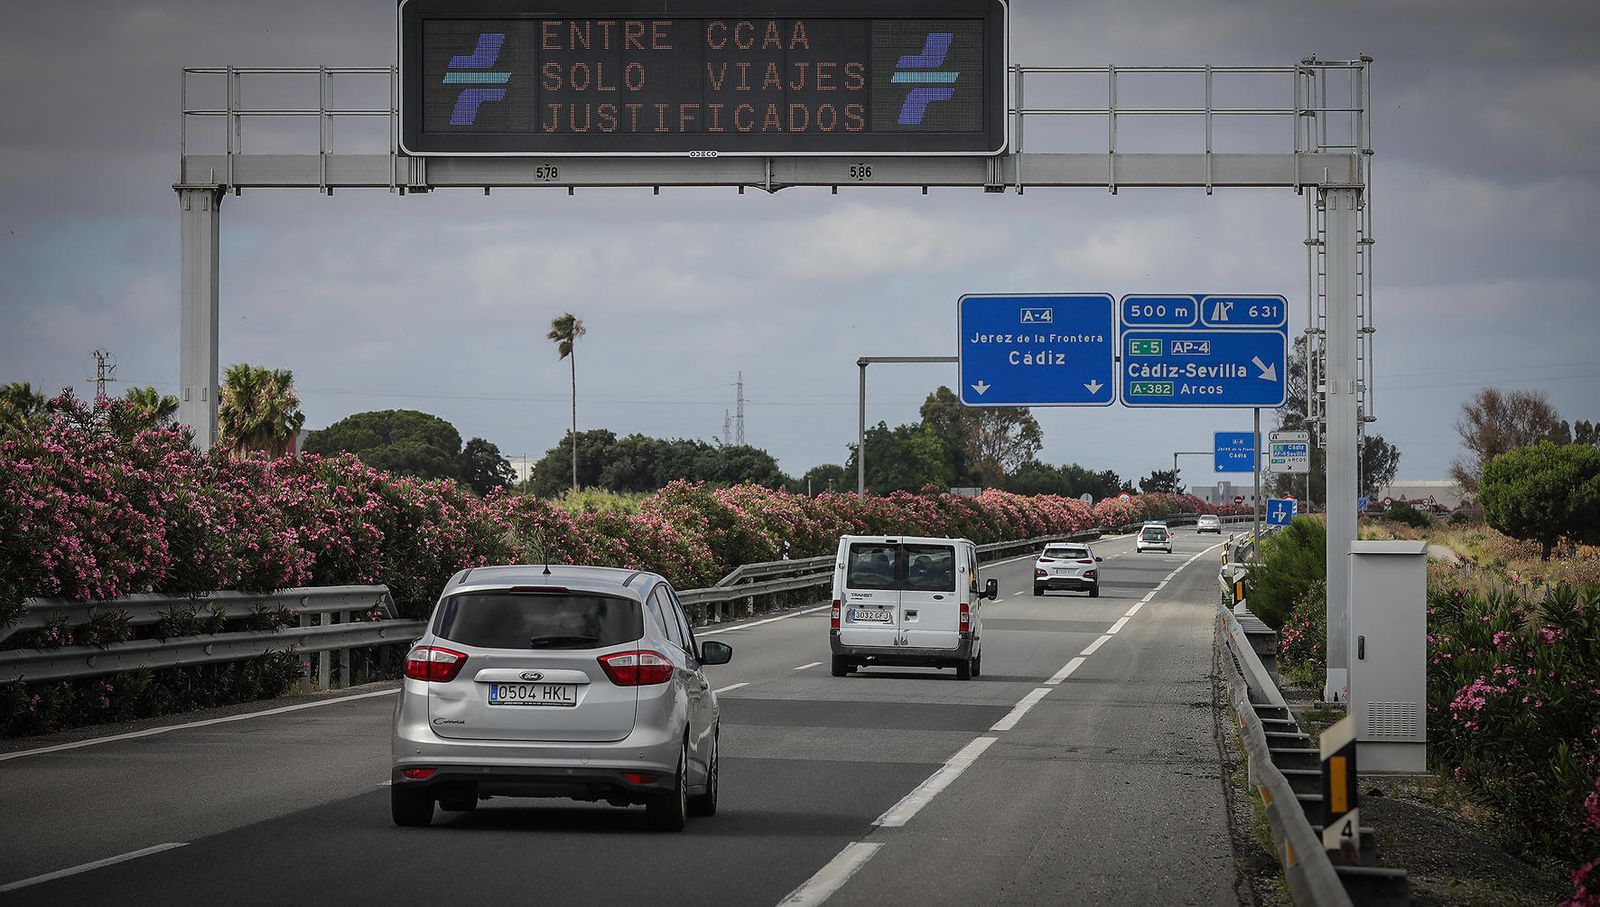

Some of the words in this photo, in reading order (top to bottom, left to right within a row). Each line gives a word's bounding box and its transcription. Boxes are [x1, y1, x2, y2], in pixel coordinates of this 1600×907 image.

[542, 20, 674, 50] ENTRE
[707, 20, 810, 50] CCAA
[542, 62, 646, 92] SOLO
[707, 62, 866, 92] VIAJES
[542, 103, 866, 133] JUSTIFICADOS
[536, 167, 558, 178] 5,78
[849, 167, 872, 178] 5,86
[1022, 310, 1052, 322] A-4
[1131, 305, 1167, 317] 500
[1175, 308, 1188, 317] m
[1248, 305, 1278, 318] 631
[970, 332, 1013, 344] Jerez
[1017, 334, 1030, 343] de
[1034, 333, 1046, 343] la
[1049, 333, 1104, 343] Frontera
[1130, 341, 1160, 354] E-5
[1172, 341, 1210, 354] AP-4
[1008, 350, 1066, 365] Cádiz
[1128, 362, 1247, 378] Cádiz-Sevilla
[1132, 384, 1171, 394] A-382
[1180, 383, 1224, 395] Arcos
[856, 611, 873, 619] 3032
[499, 685, 536, 700] 0504
[543, 686, 571, 700] HKL
[1341, 820, 1353, 838] 4
